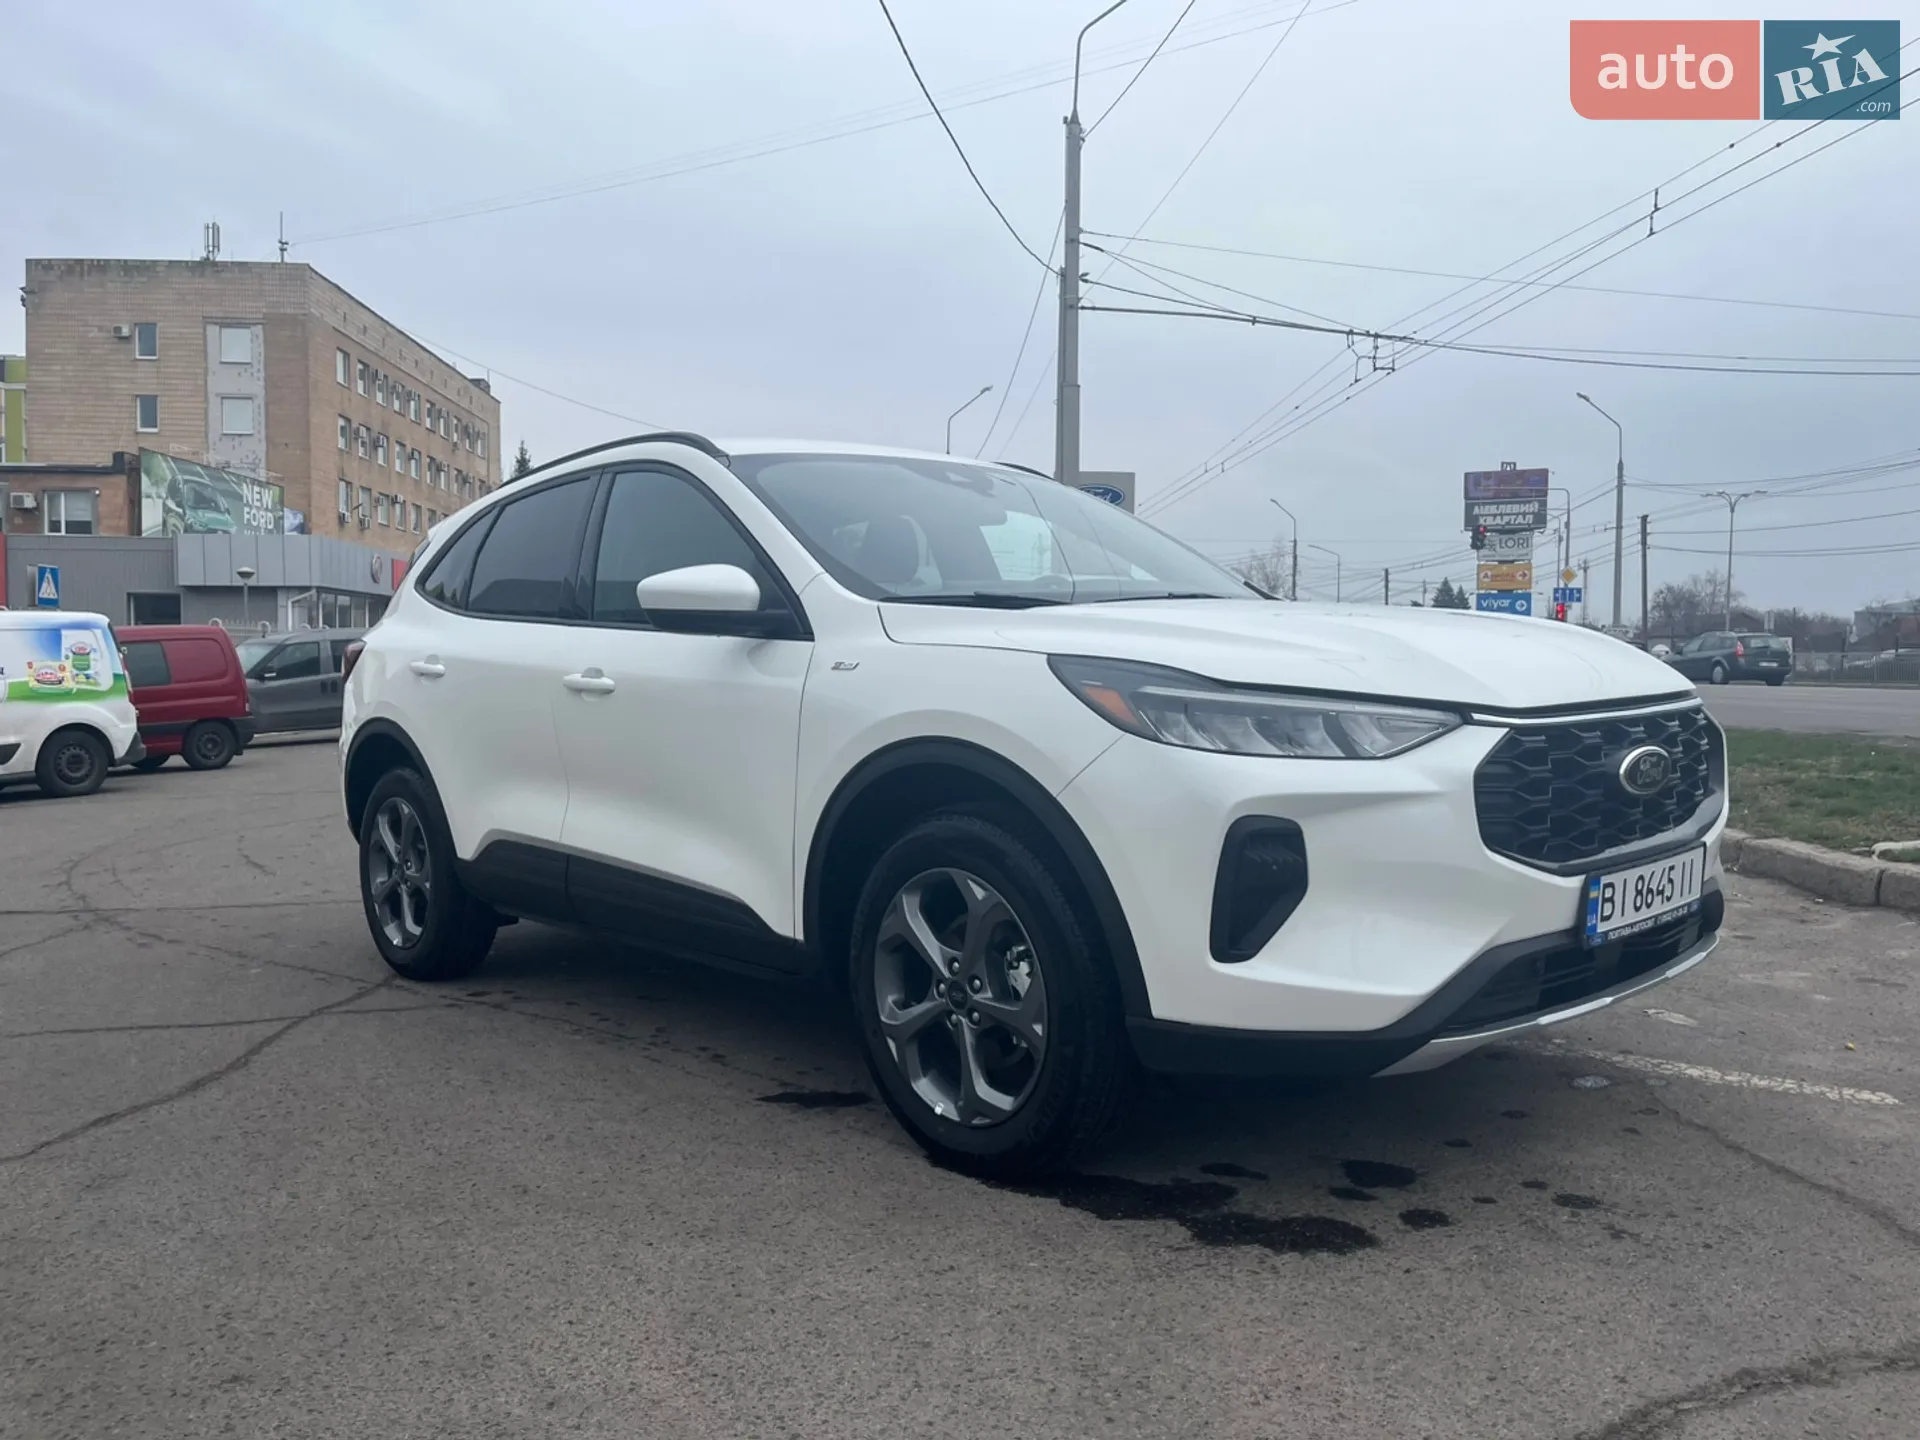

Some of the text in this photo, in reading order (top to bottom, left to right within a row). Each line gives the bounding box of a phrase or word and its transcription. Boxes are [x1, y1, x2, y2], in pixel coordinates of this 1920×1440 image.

[243, 482, 273, 510] NEW
[243, 506, 275, 530] FORD
[1478, 514, 1534, 525] КВАРТАЛ
[1481, 598, 1513, 610] viyar
[1601, 878, 1627, 923] BI
[1633, 863, 1676, 913] 8645
